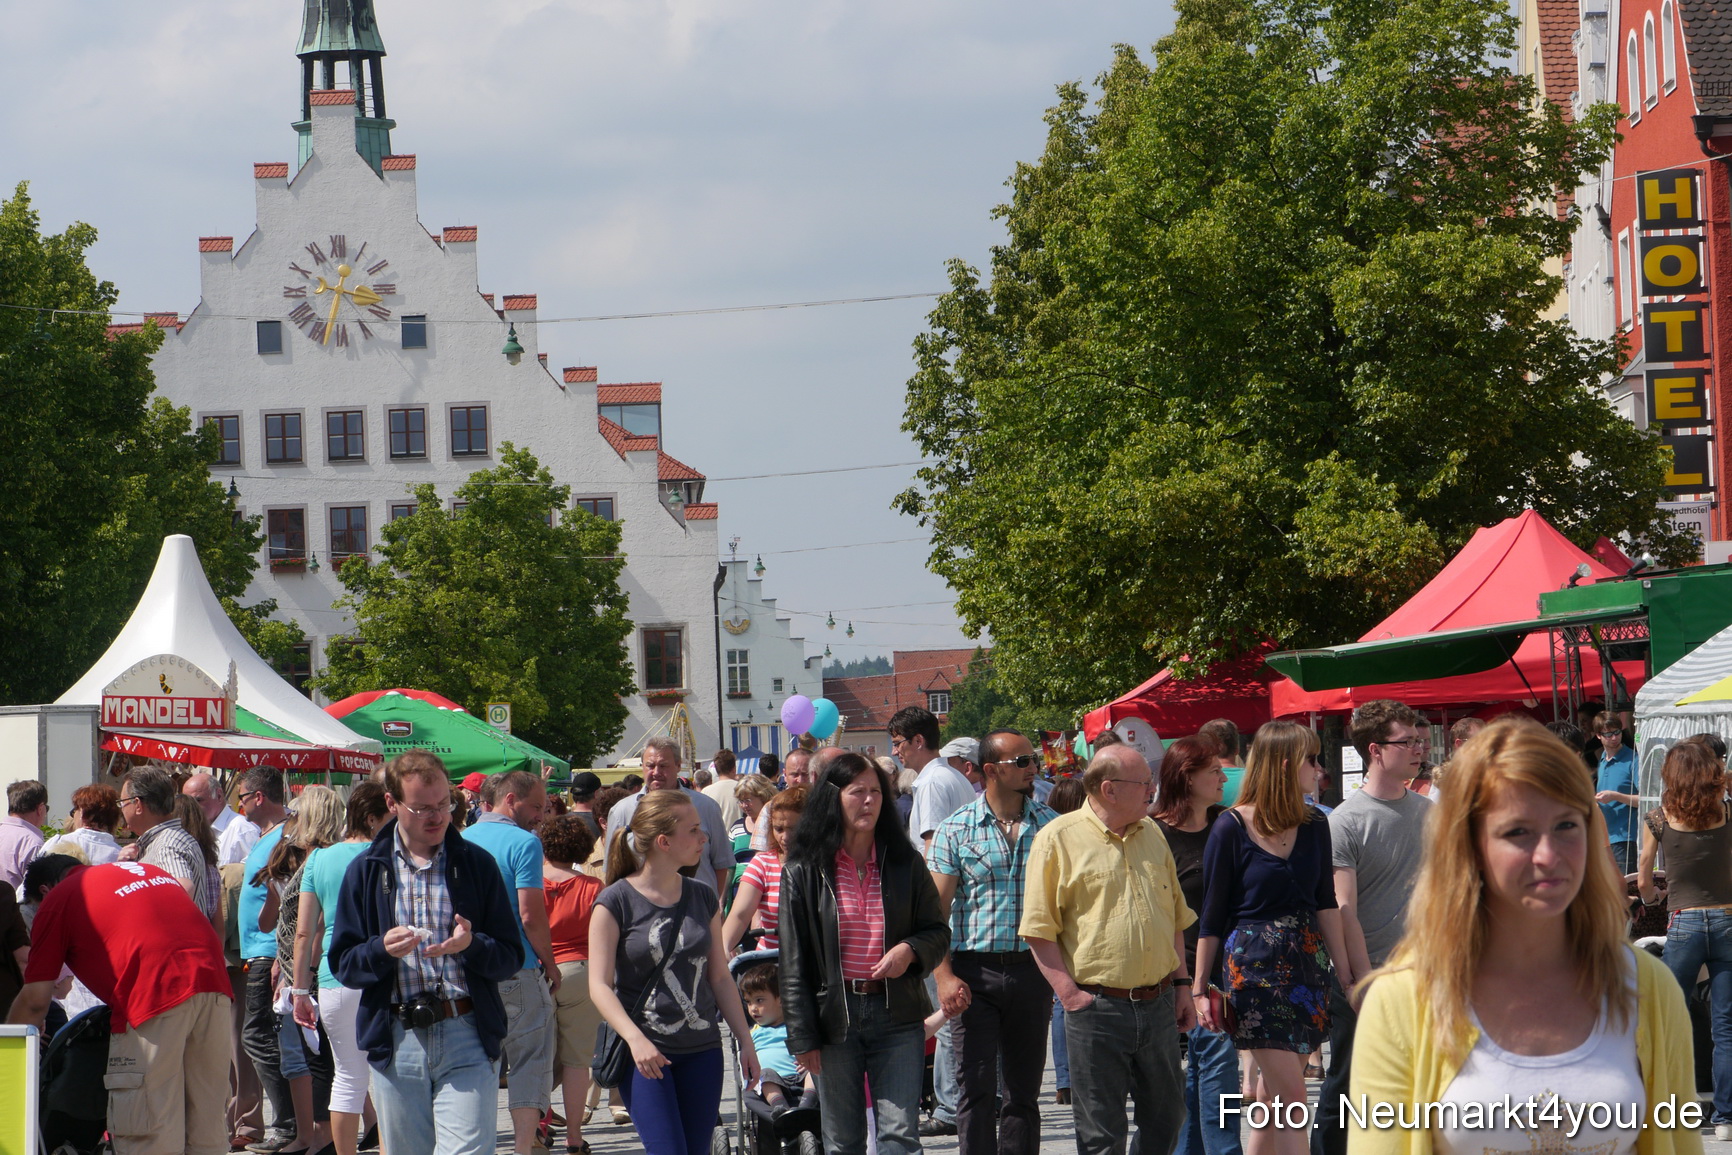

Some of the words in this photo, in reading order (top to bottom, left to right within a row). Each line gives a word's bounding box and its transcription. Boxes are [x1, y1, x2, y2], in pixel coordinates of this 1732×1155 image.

[330, 235, 346, 258] XII
[1643, 177, 1703, 486] HOTEL
[104, 697, 222, 726] MANDELN
[114, 880, 149, 898] TEAM
